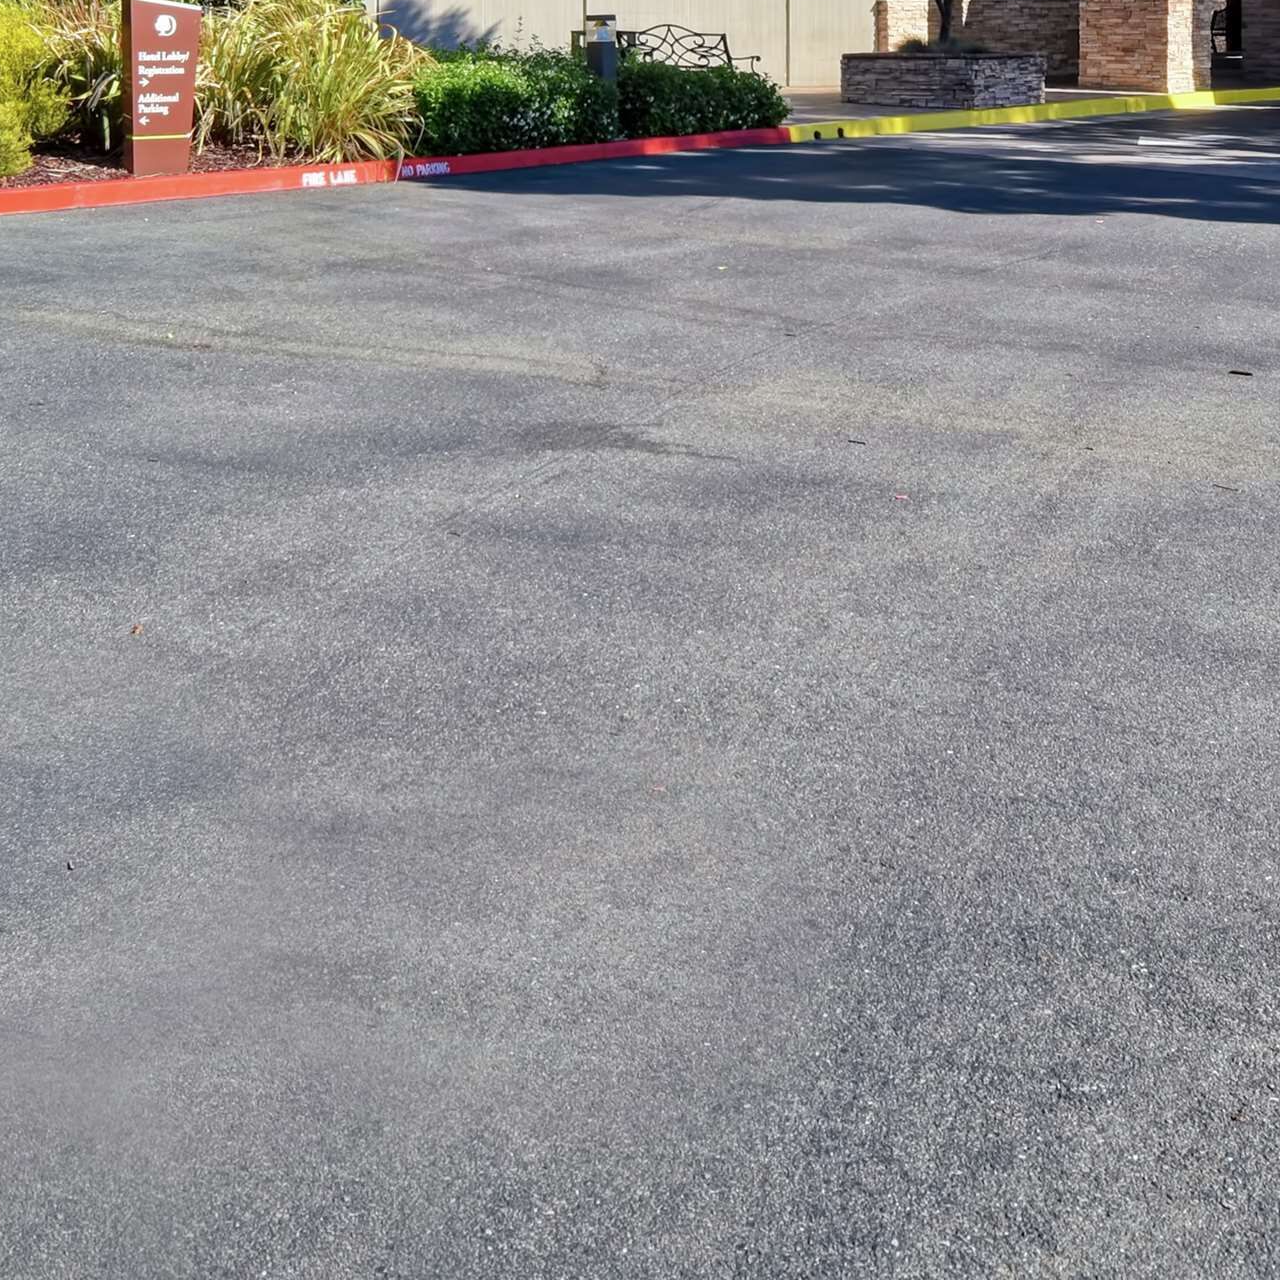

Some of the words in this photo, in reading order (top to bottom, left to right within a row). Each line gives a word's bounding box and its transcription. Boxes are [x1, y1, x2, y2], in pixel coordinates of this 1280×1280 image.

[138, 51, 161, 61] Hotel
[162, 51, 190, 64] Lobby/
[138, 65, 185, 77] Registration
[138, 92, 180, 103] Additional
[138, 103, 169, 115] Parking
[402, 165, 414, 177] NO
[416, 162, 450, 176] PARKING
[302, 172, 325, 187] FIRE
[330, 169, 357, 184] LANE
